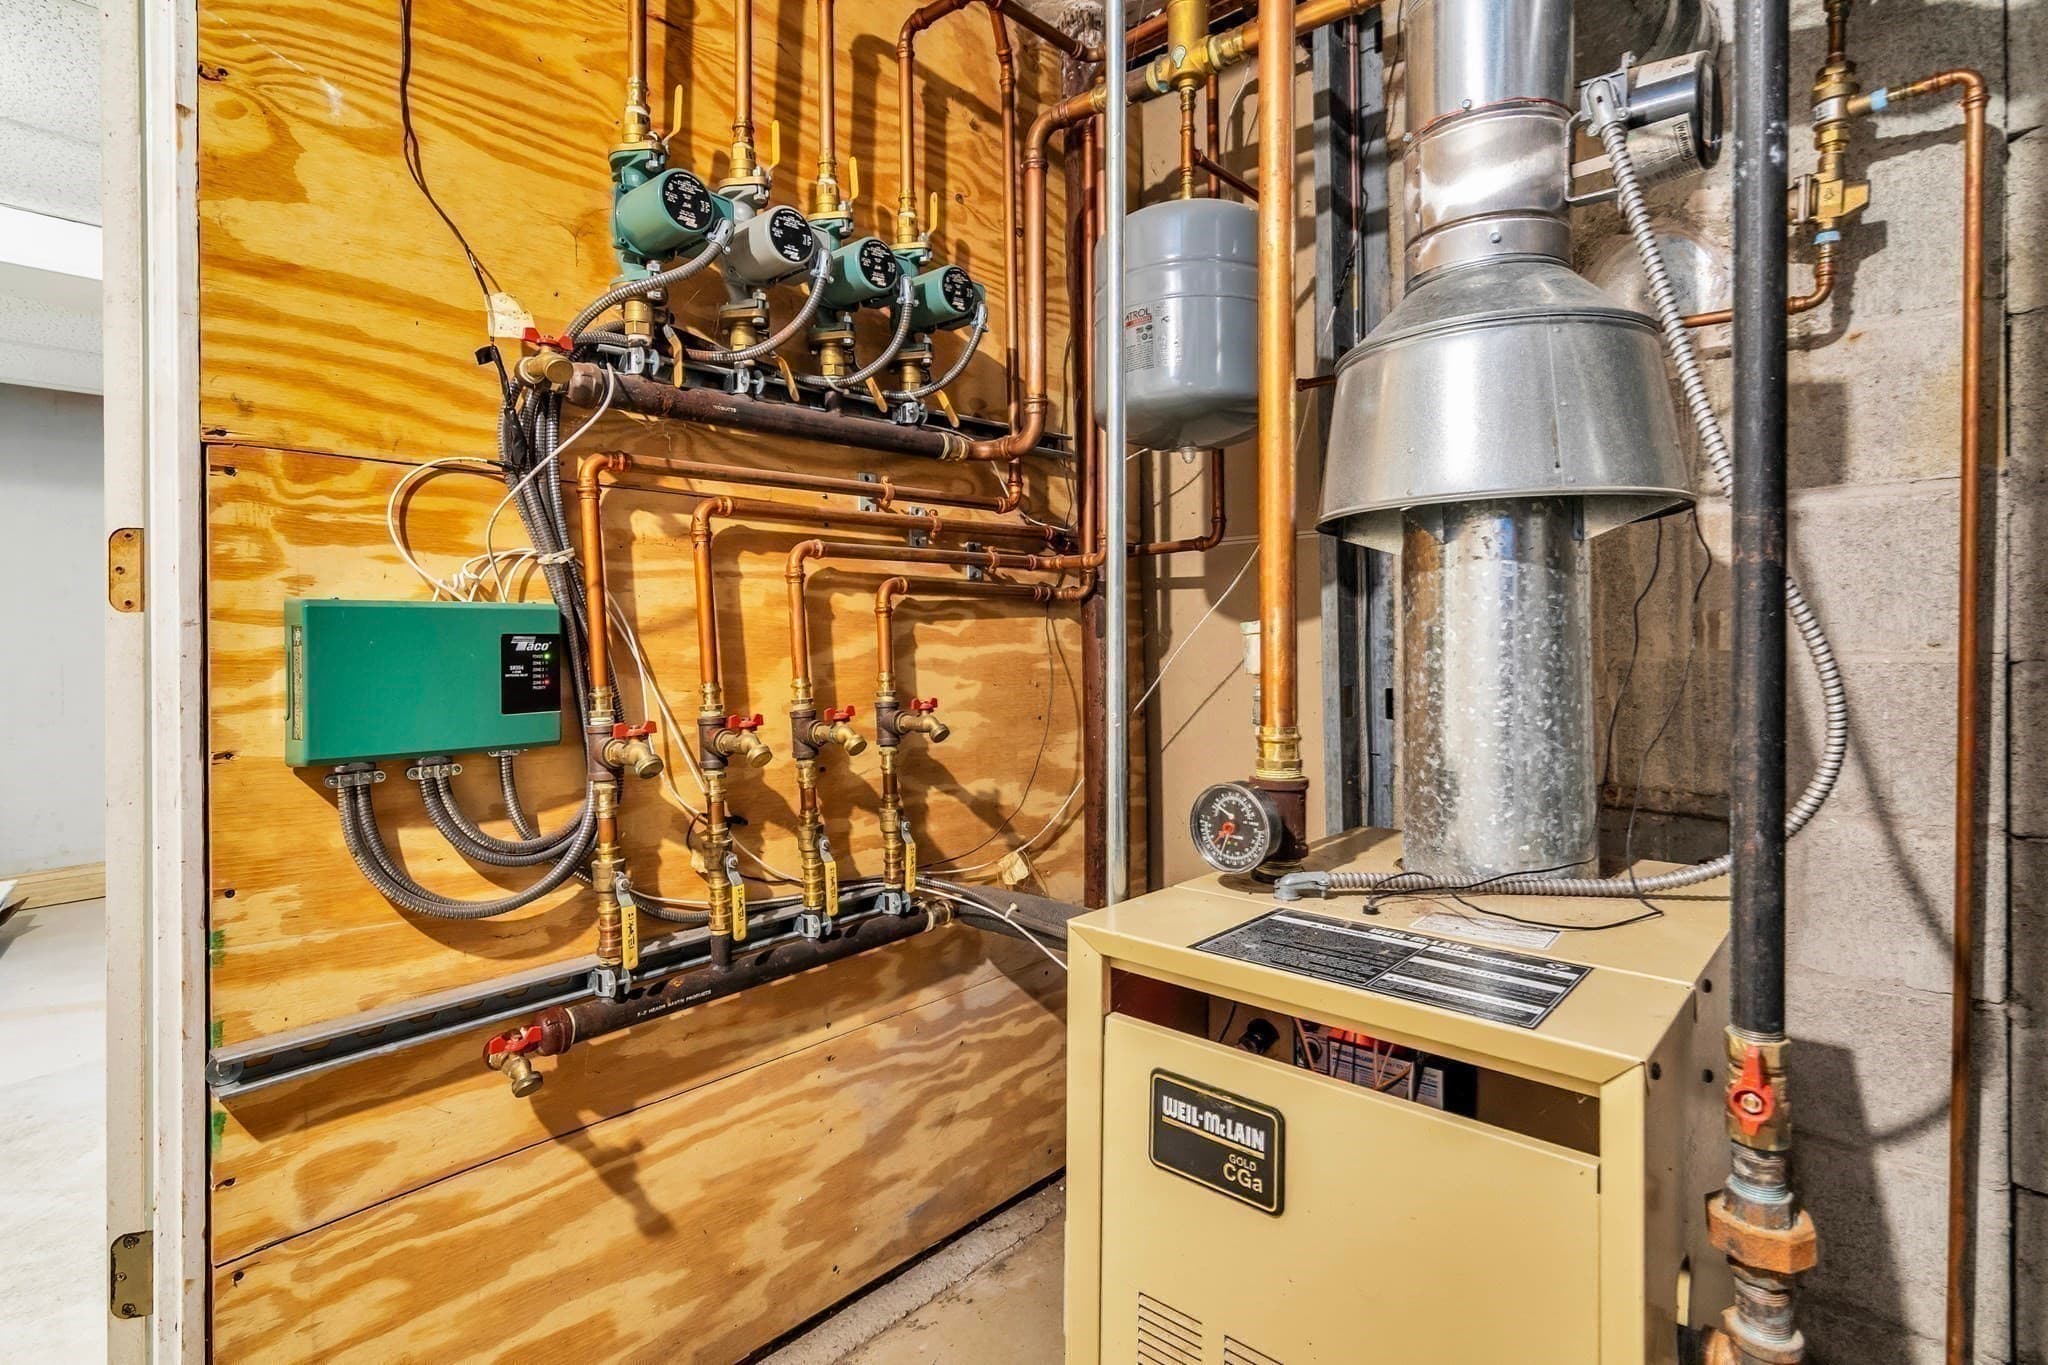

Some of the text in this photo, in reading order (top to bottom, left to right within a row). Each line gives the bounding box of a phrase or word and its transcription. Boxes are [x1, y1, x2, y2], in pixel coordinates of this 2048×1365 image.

[511, 636, 549, 651] Taco
[1228, 1153, 1257, 1172] GOLD
[1222, 1162, 1264, 1194] CGa
